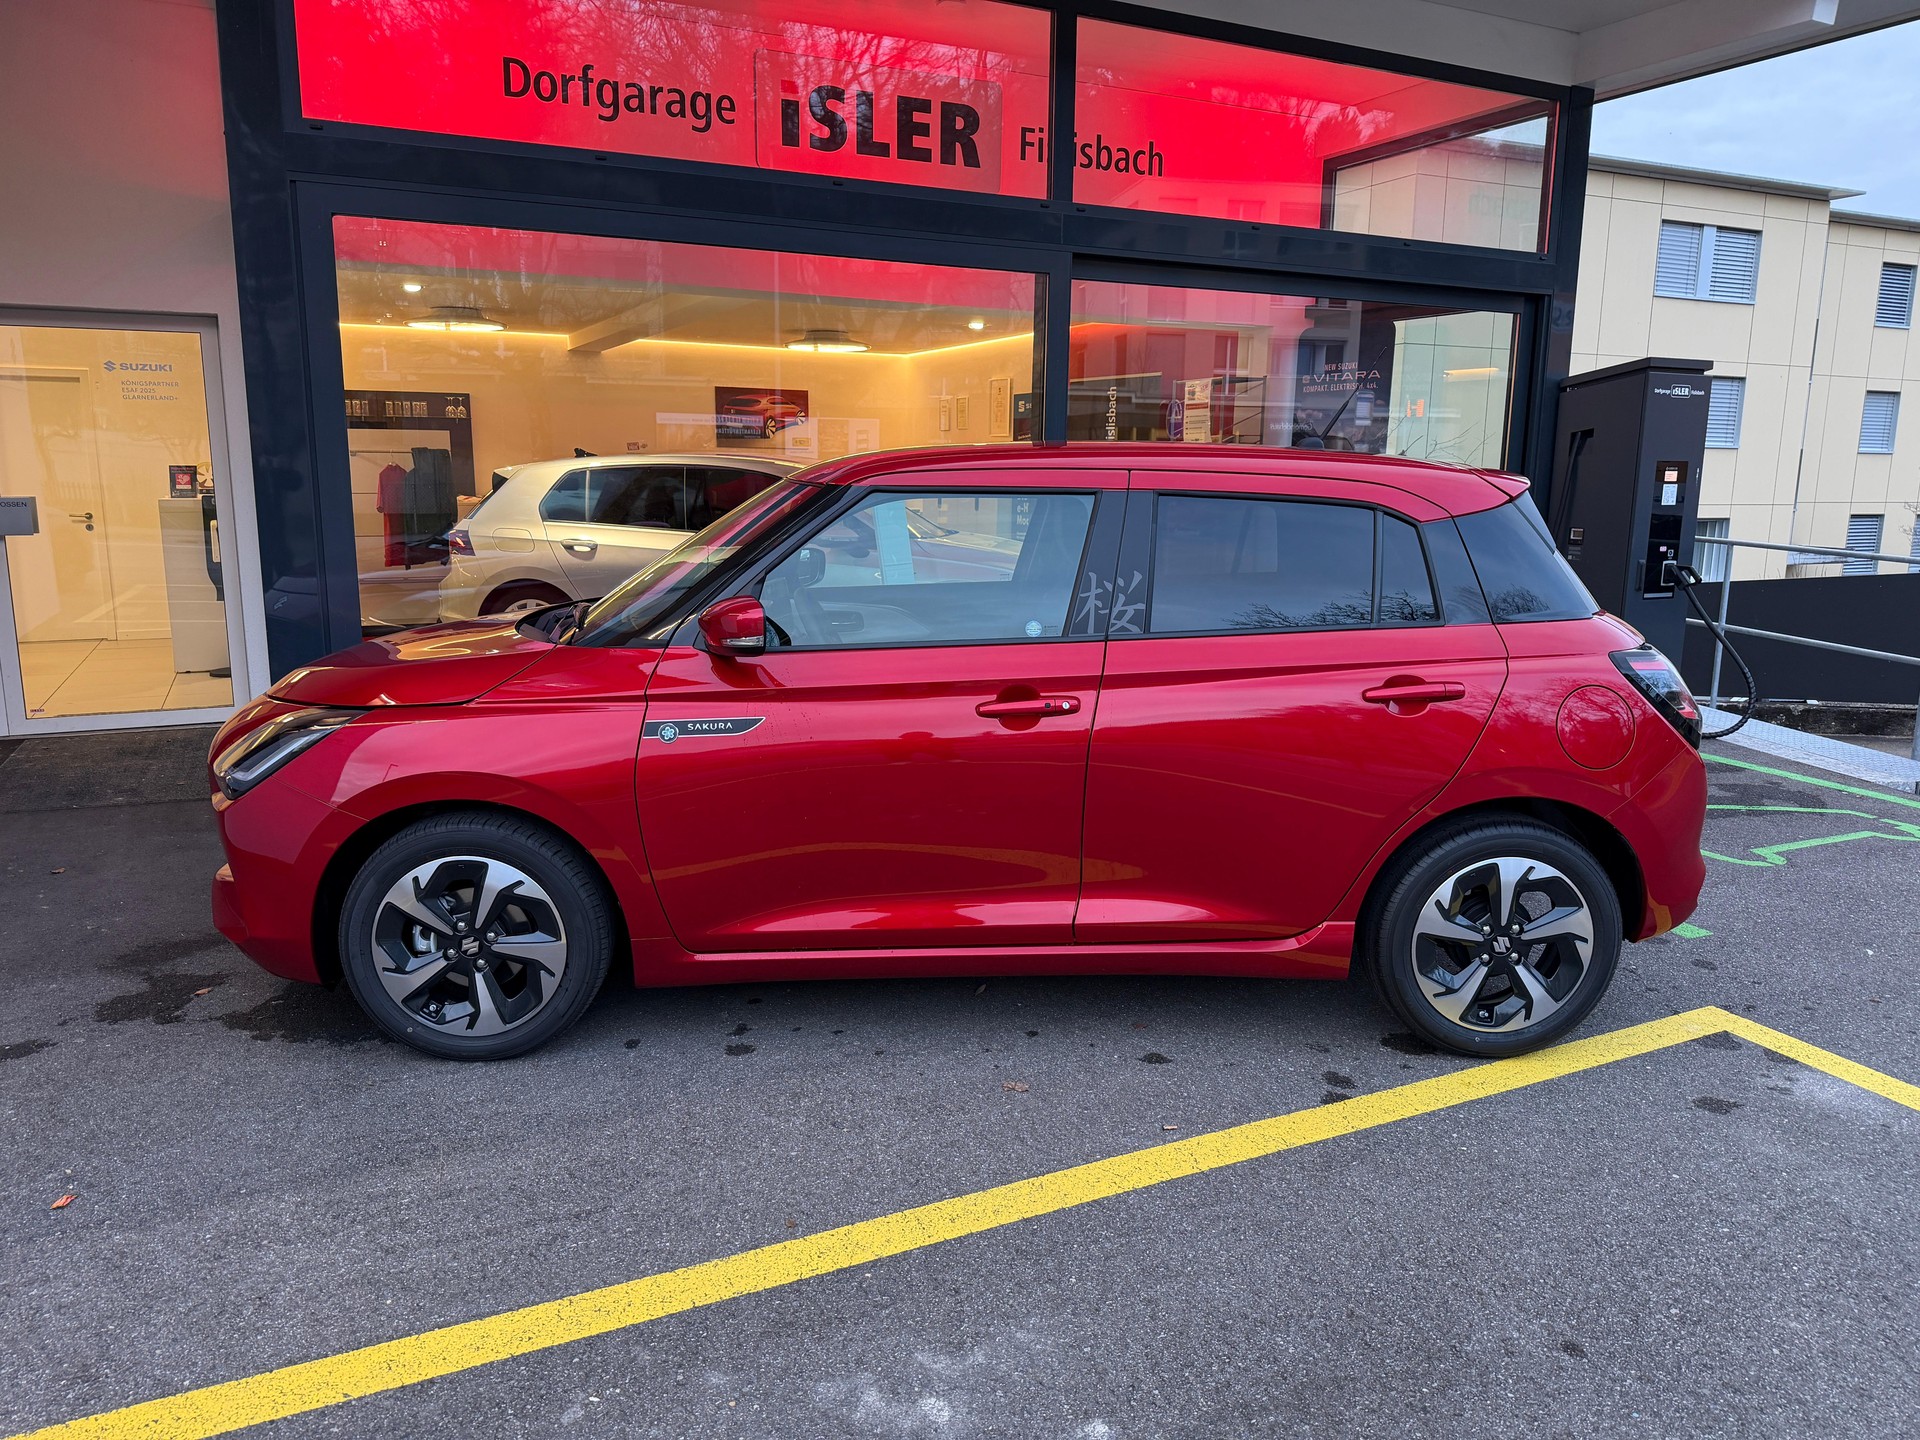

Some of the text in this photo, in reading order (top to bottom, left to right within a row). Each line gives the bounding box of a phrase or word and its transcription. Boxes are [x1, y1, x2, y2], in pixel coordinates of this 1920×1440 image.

[502, 56, 1163, 177] Dorfgarage iSLER Fiisbach
[119, 362, 173, 372] SUZUKI
[1324, 362, 1358, 371] NEW SUZUKI
[1313, 370, 1381, 382] VITARA
[1105, 386, 1117, 440] islisbach
[1075, 570, 1146, 635] 桜
[687, 722, 733, 731] SAKURA
